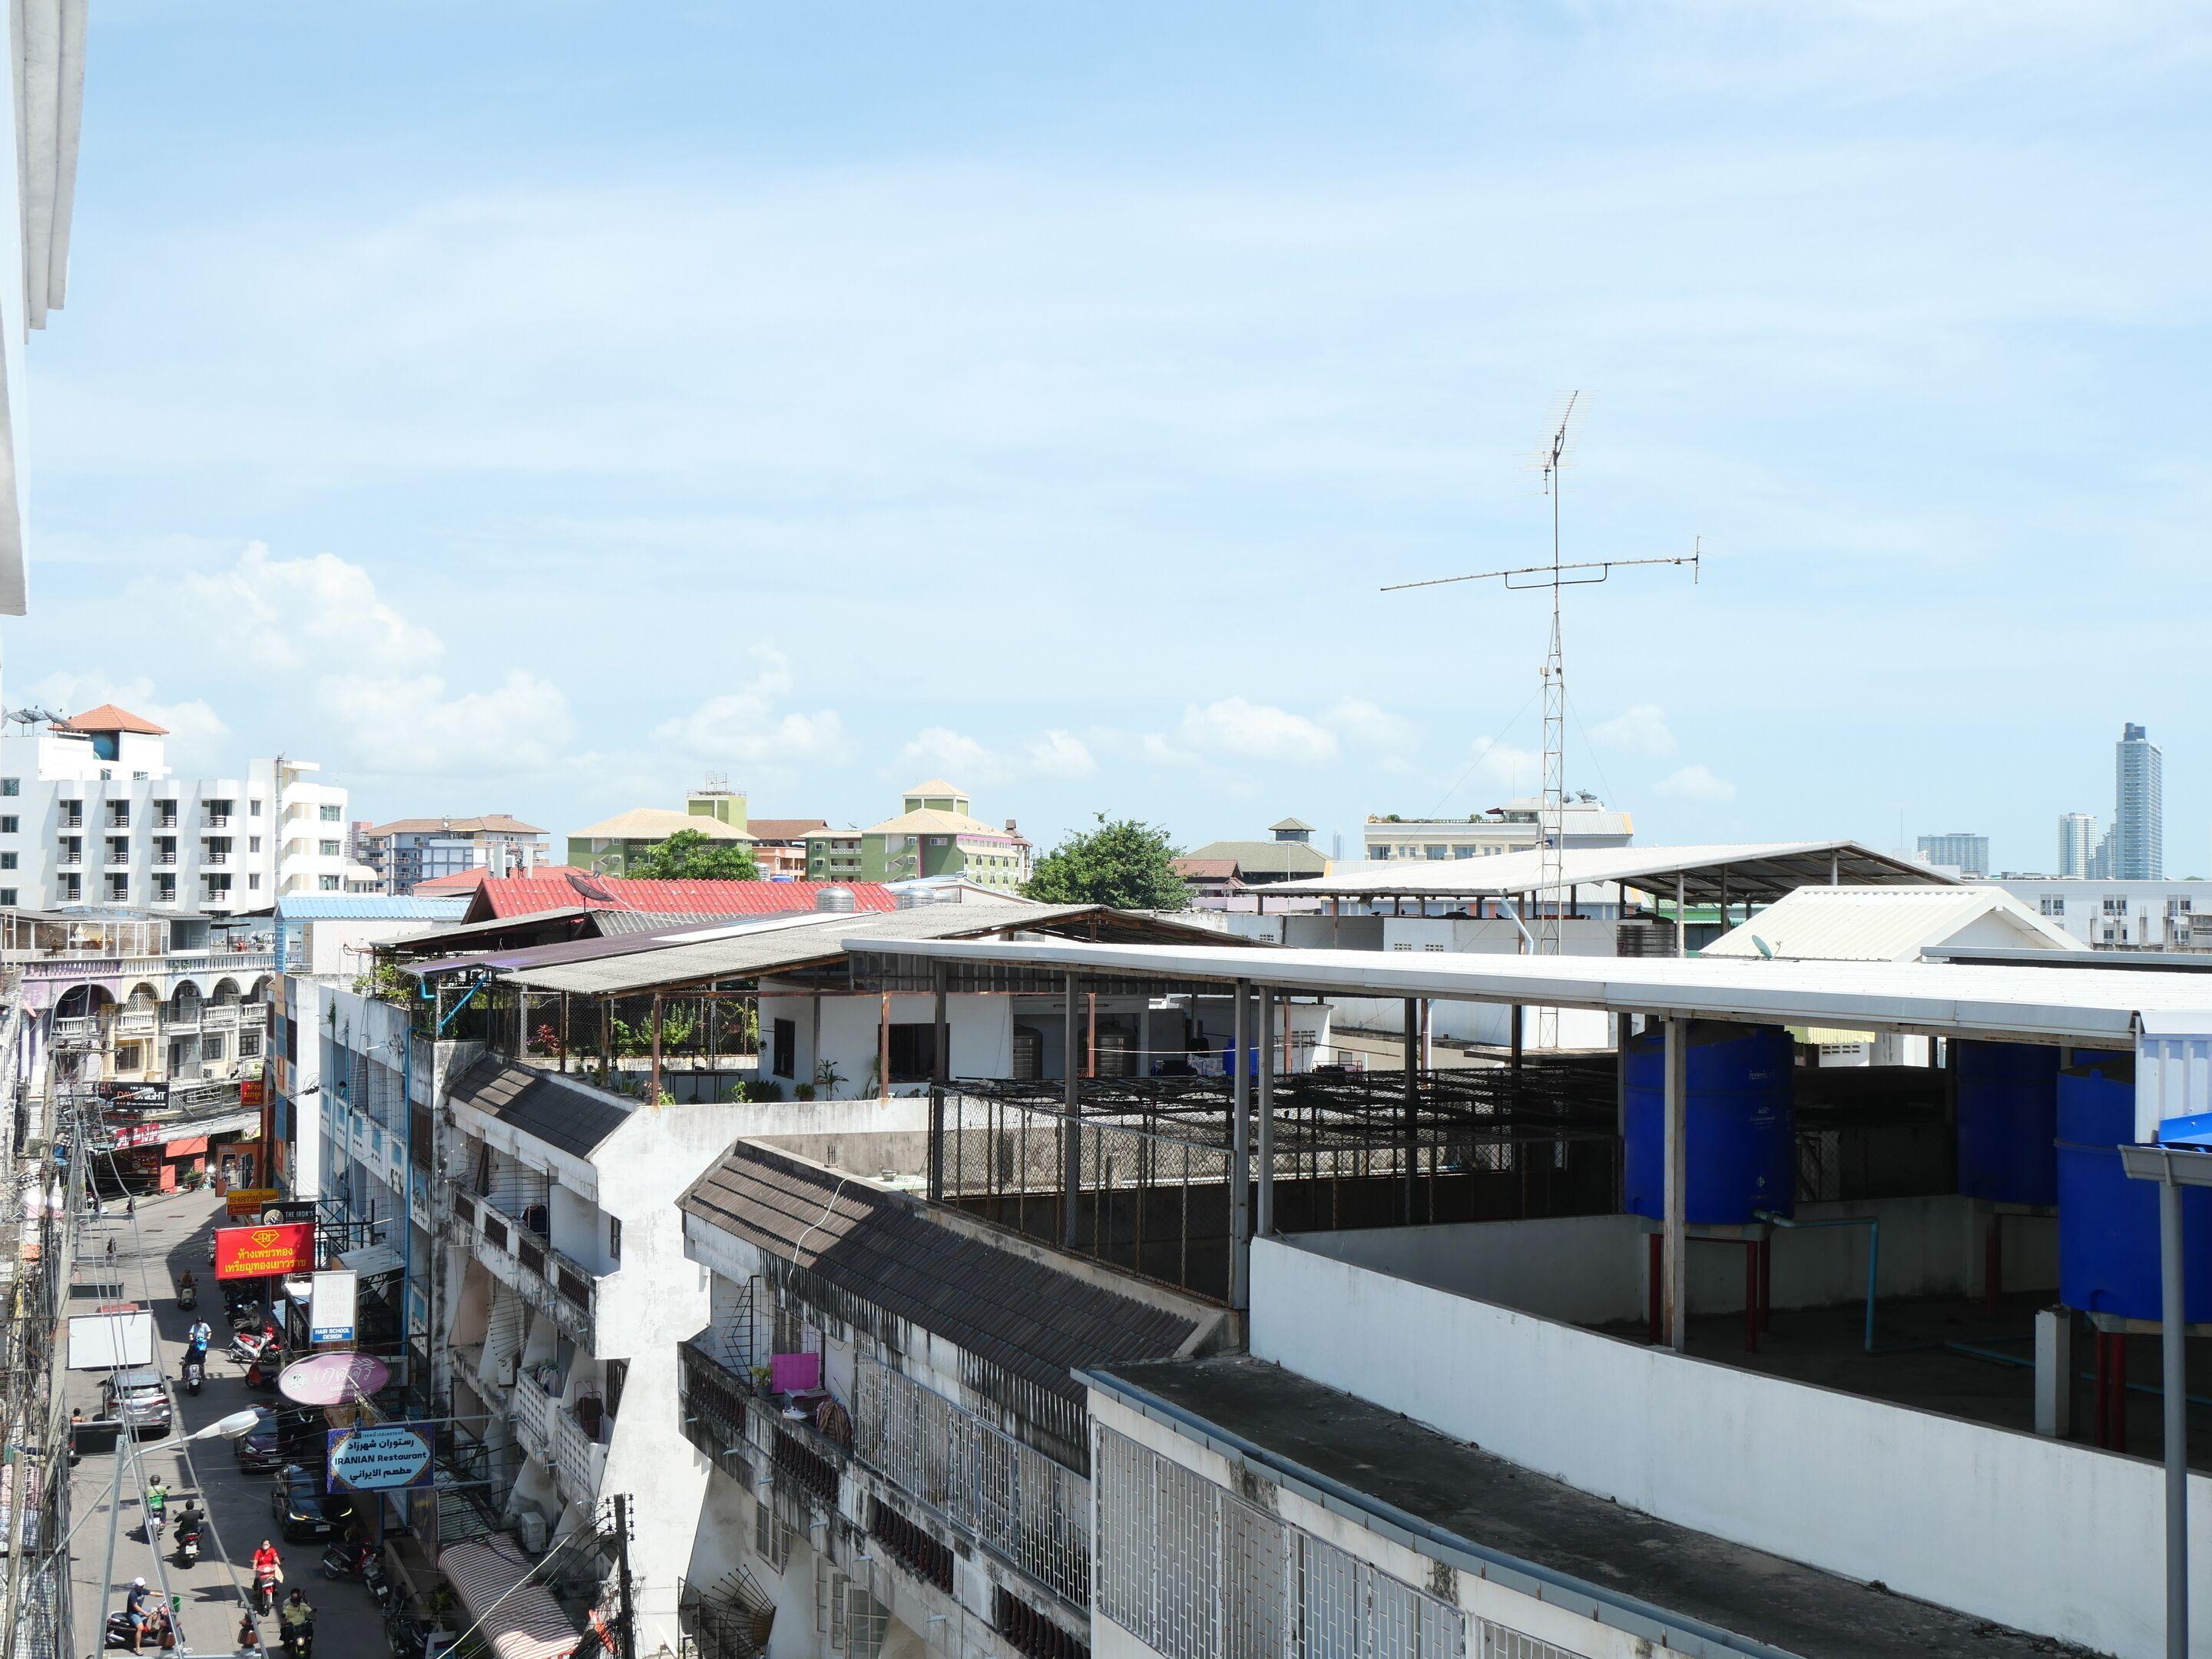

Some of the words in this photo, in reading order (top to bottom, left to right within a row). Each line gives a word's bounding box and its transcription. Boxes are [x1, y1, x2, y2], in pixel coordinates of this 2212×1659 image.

[237, 1247, 293, 1260] ห้างเพชรทอง
[348, 1439, 377, 1452] شهرزاد
[379, 1439, 415, 1449] رستوران
[335, 1454, 375, 1465] IRANIAN
[377, 1452, 427, 1462] Restaurant
[382, 1467, 412, 1479] مطعم
